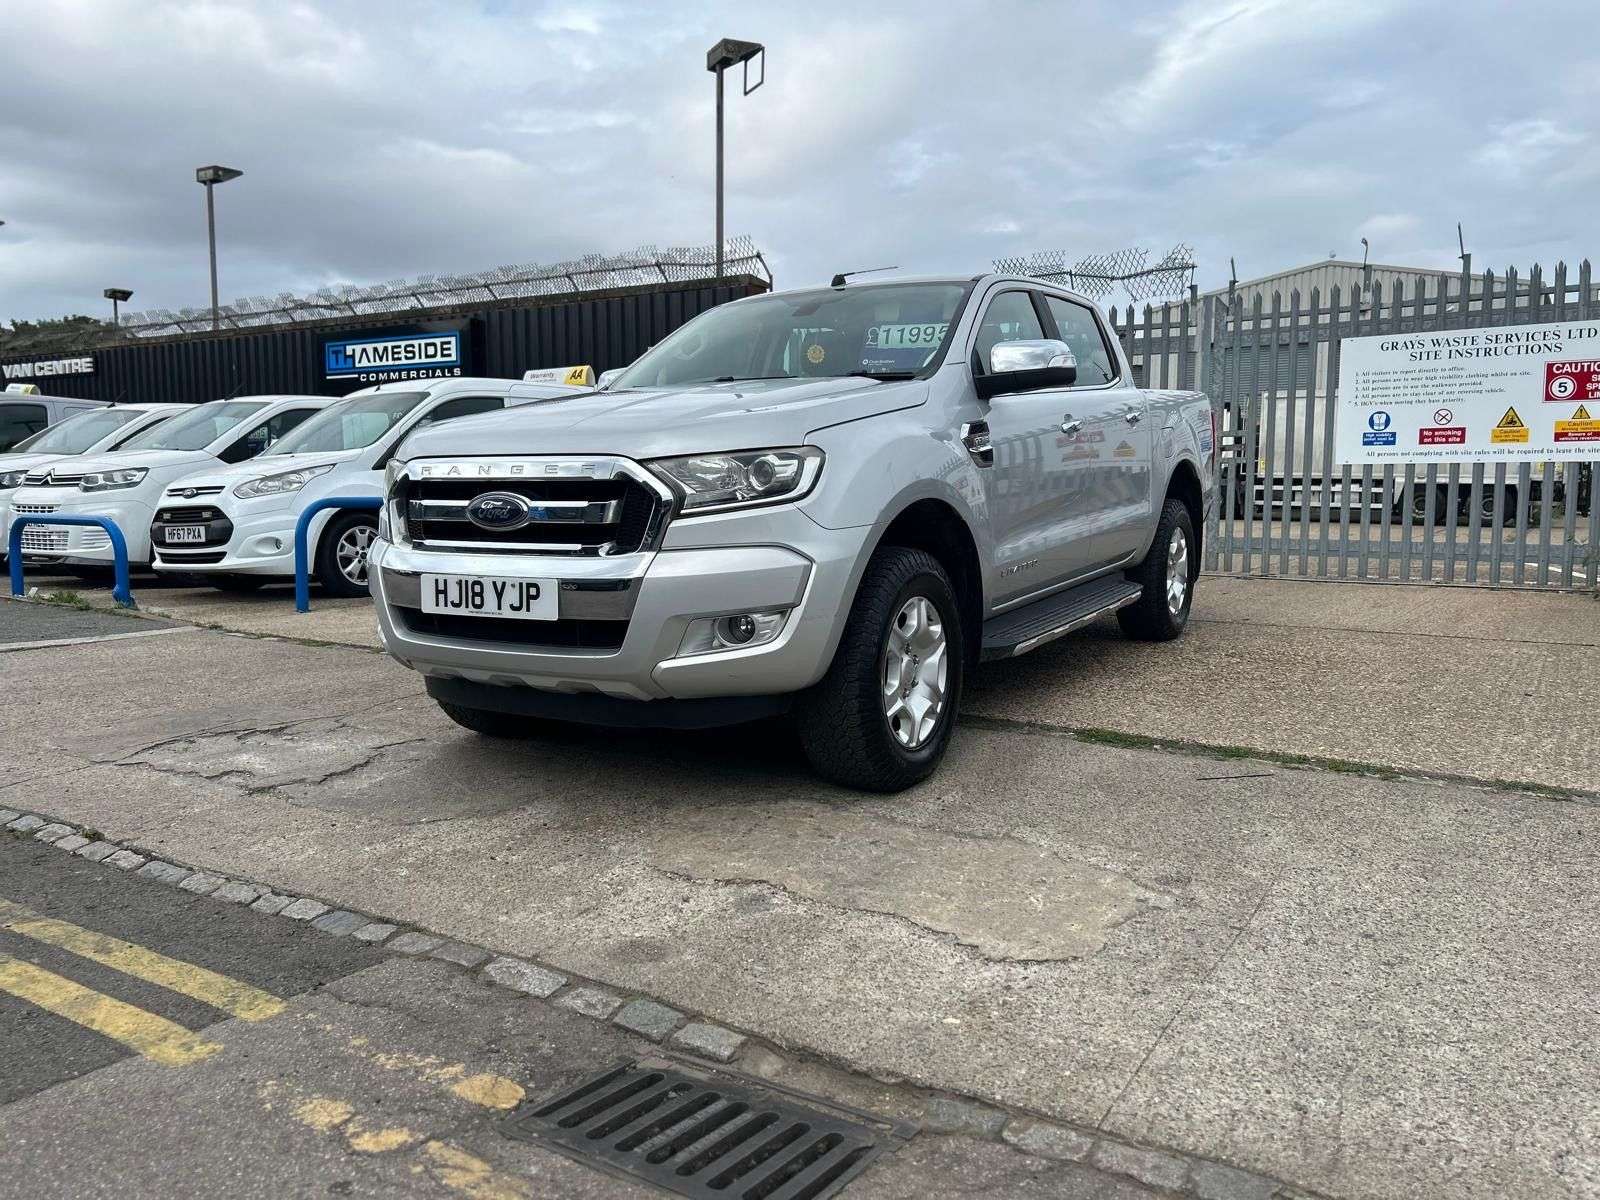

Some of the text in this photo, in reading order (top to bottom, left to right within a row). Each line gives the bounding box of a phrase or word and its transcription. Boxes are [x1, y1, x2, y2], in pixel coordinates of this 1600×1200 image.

[1380, 327, 1598, 352] GRAYS WASTE SERVICES LTD
[330, 340, 452, 368] THAMESIDE
[1409, 343, 1563, 361] SITE INSTRUCTIONS
[2, 357, 94, 379] VAN CENTRE
[359, 368, 461, 382] COMMERCIALS
[569, 368, 584, 380] AA
[1557, 381, 1568, 394] 5
[1434, 429, 1462, 437] smoking
[1517, 447, 1545, 455] required
[420, 463, 597, 476] RANGER
[478, 500, 511, 521] Ford
[167, 527, 202, 540] HF67 PXA
[434, 578, 541, 613] HJ18 YJP
